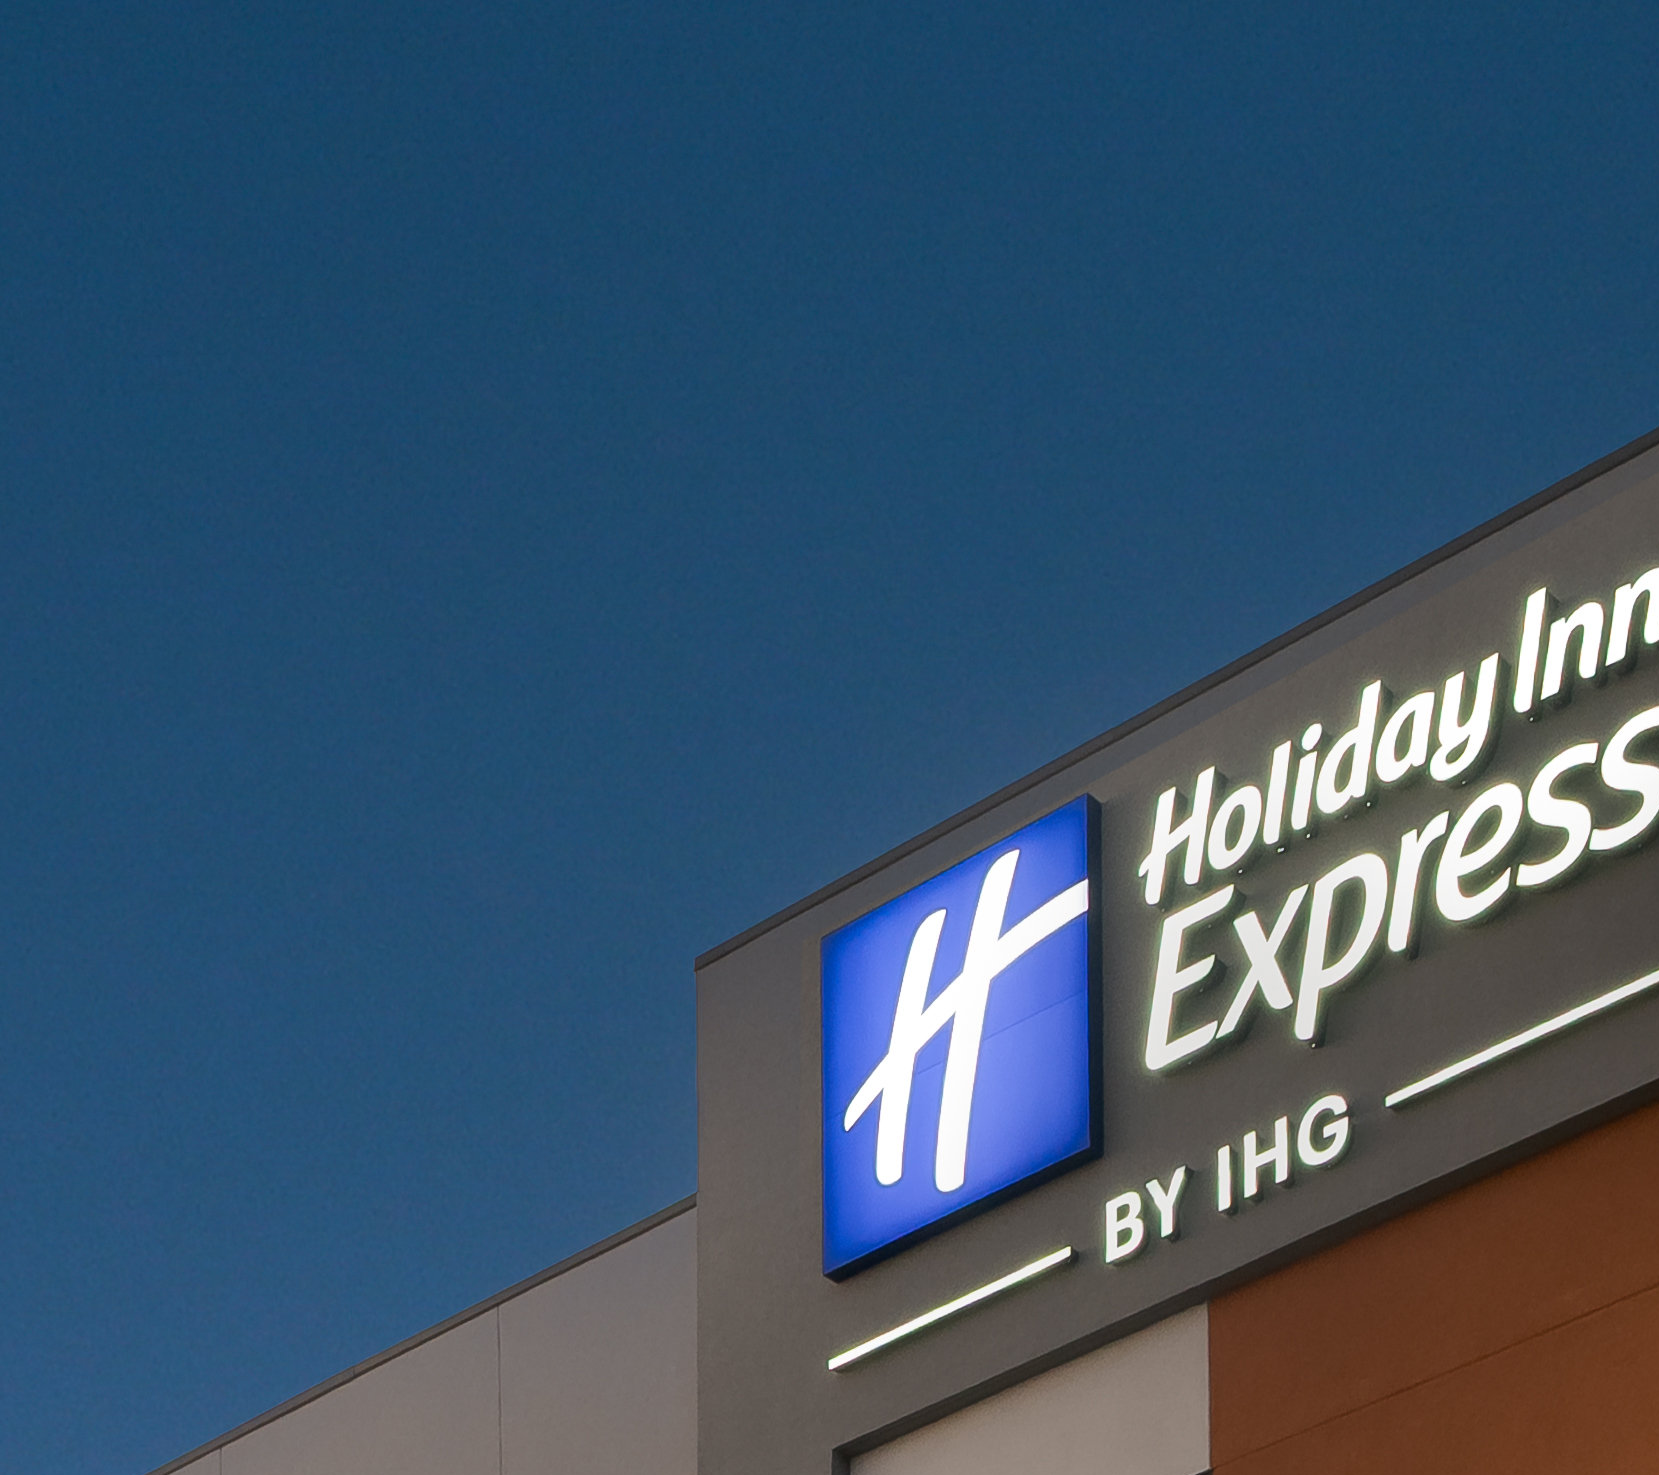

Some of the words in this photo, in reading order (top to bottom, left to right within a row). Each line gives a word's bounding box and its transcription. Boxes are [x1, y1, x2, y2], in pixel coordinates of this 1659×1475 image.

[1137, 651, 1500, 906] Holiday
[1104, 1165, 1187, 1264] BY
[1216, 1094, 1350, 1213] IHG
